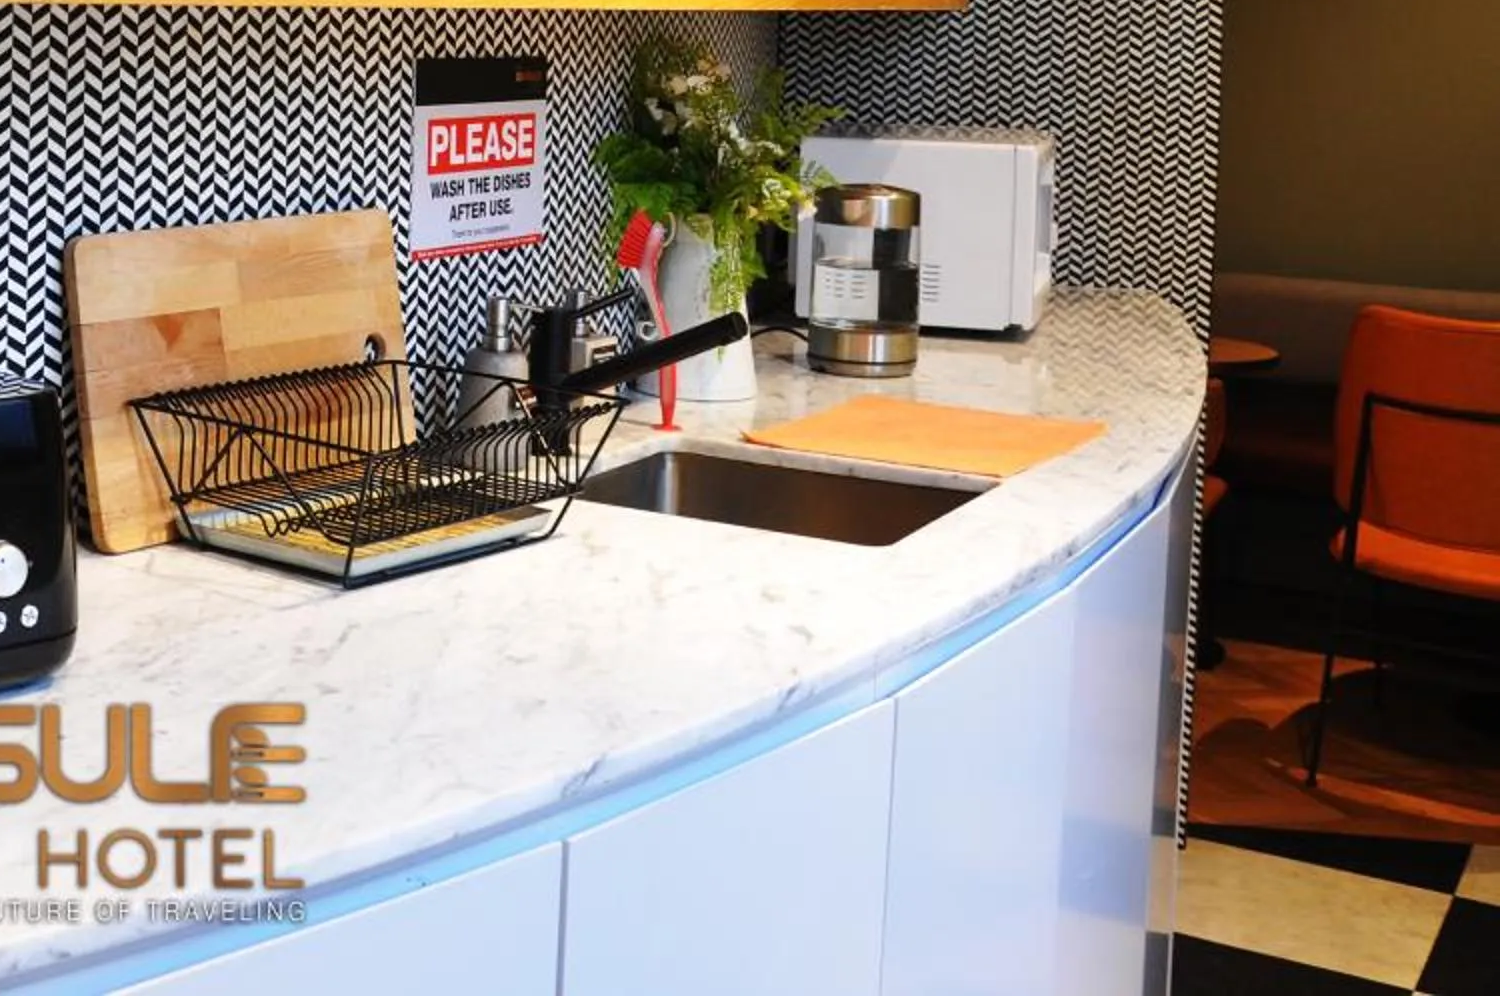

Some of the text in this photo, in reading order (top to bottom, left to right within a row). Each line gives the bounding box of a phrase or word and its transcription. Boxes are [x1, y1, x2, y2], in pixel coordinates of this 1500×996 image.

[430, 119, 533, 167] PLEASE
[430, 171, 531, 200] WASH THE DISHES
[449, 201, 487, 222] AFTER
